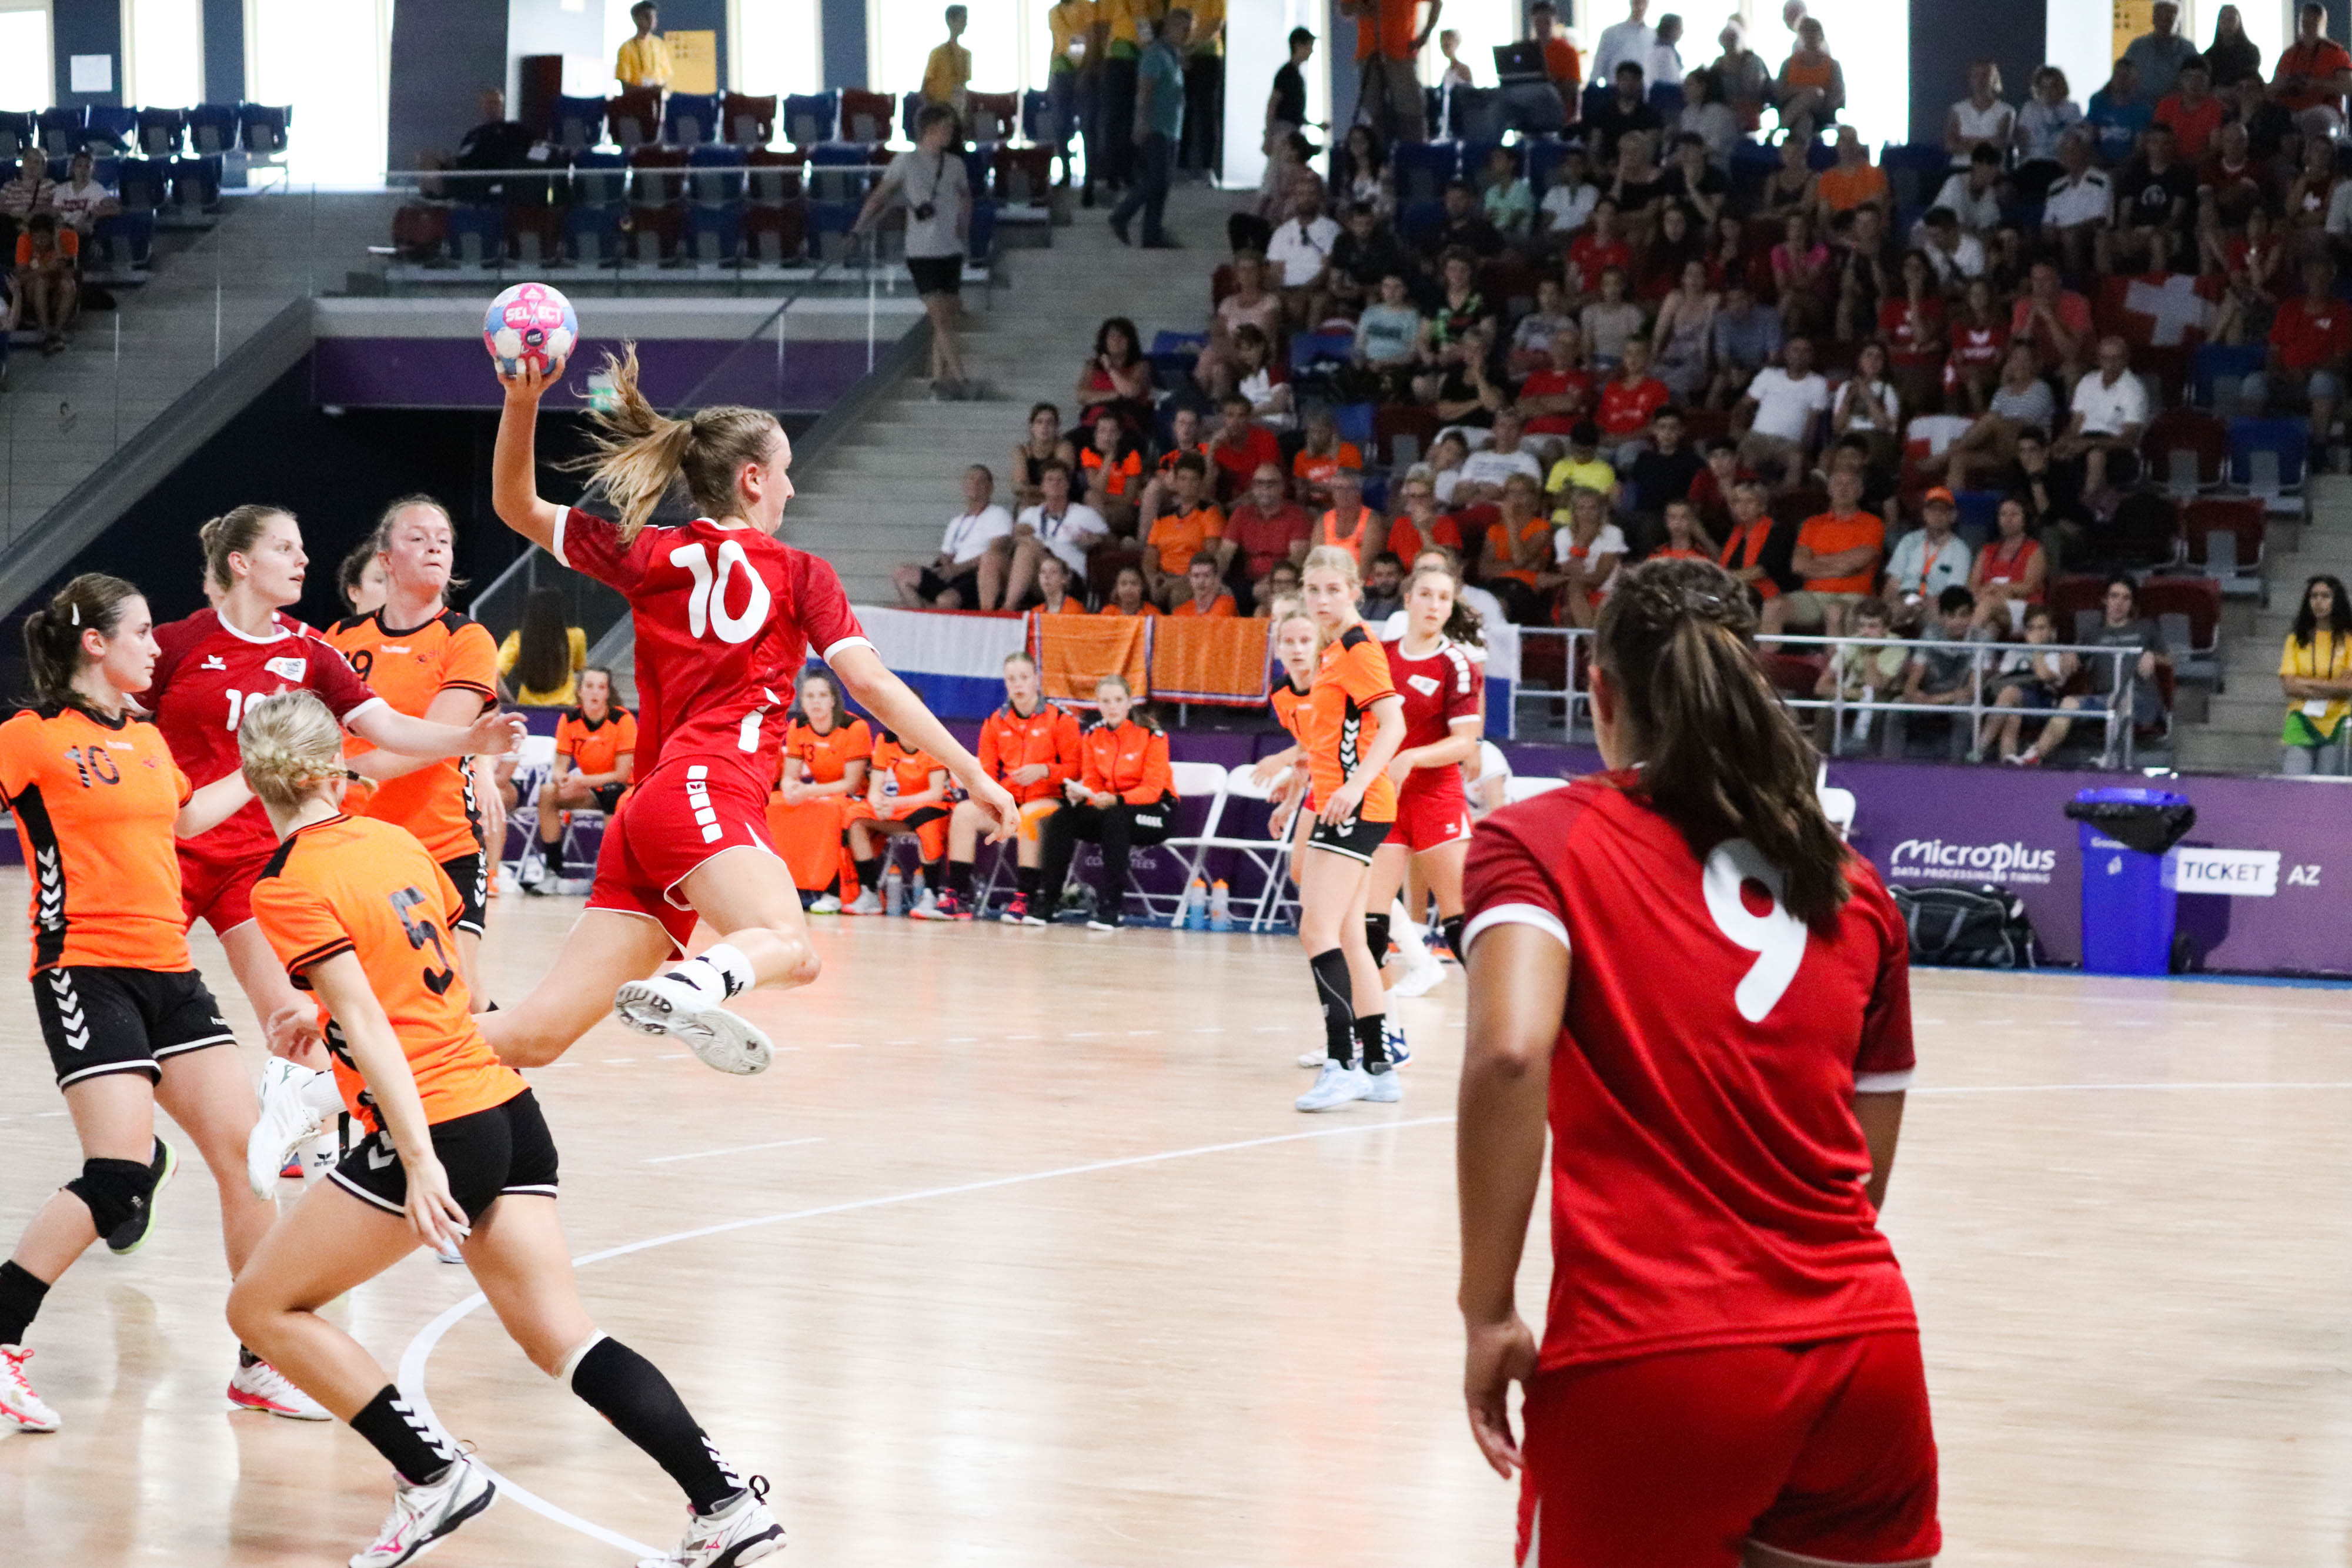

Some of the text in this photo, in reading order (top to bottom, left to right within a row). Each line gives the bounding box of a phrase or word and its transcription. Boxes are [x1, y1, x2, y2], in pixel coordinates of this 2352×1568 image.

[505, 305, 562, 322] SELECT
[669, 539, 771, 644] 10
[343, 650, 373, 682] 9
[64, 745, 120, 788] 10
[799, 743, 814, 763] 13
[1890, 839, 2056, 882] Microplus
[2184, 861, 2321, 886] TICKET AZ
[388, 885, 454, 995] 5
[1703, 837, 1808, 1023] 9
